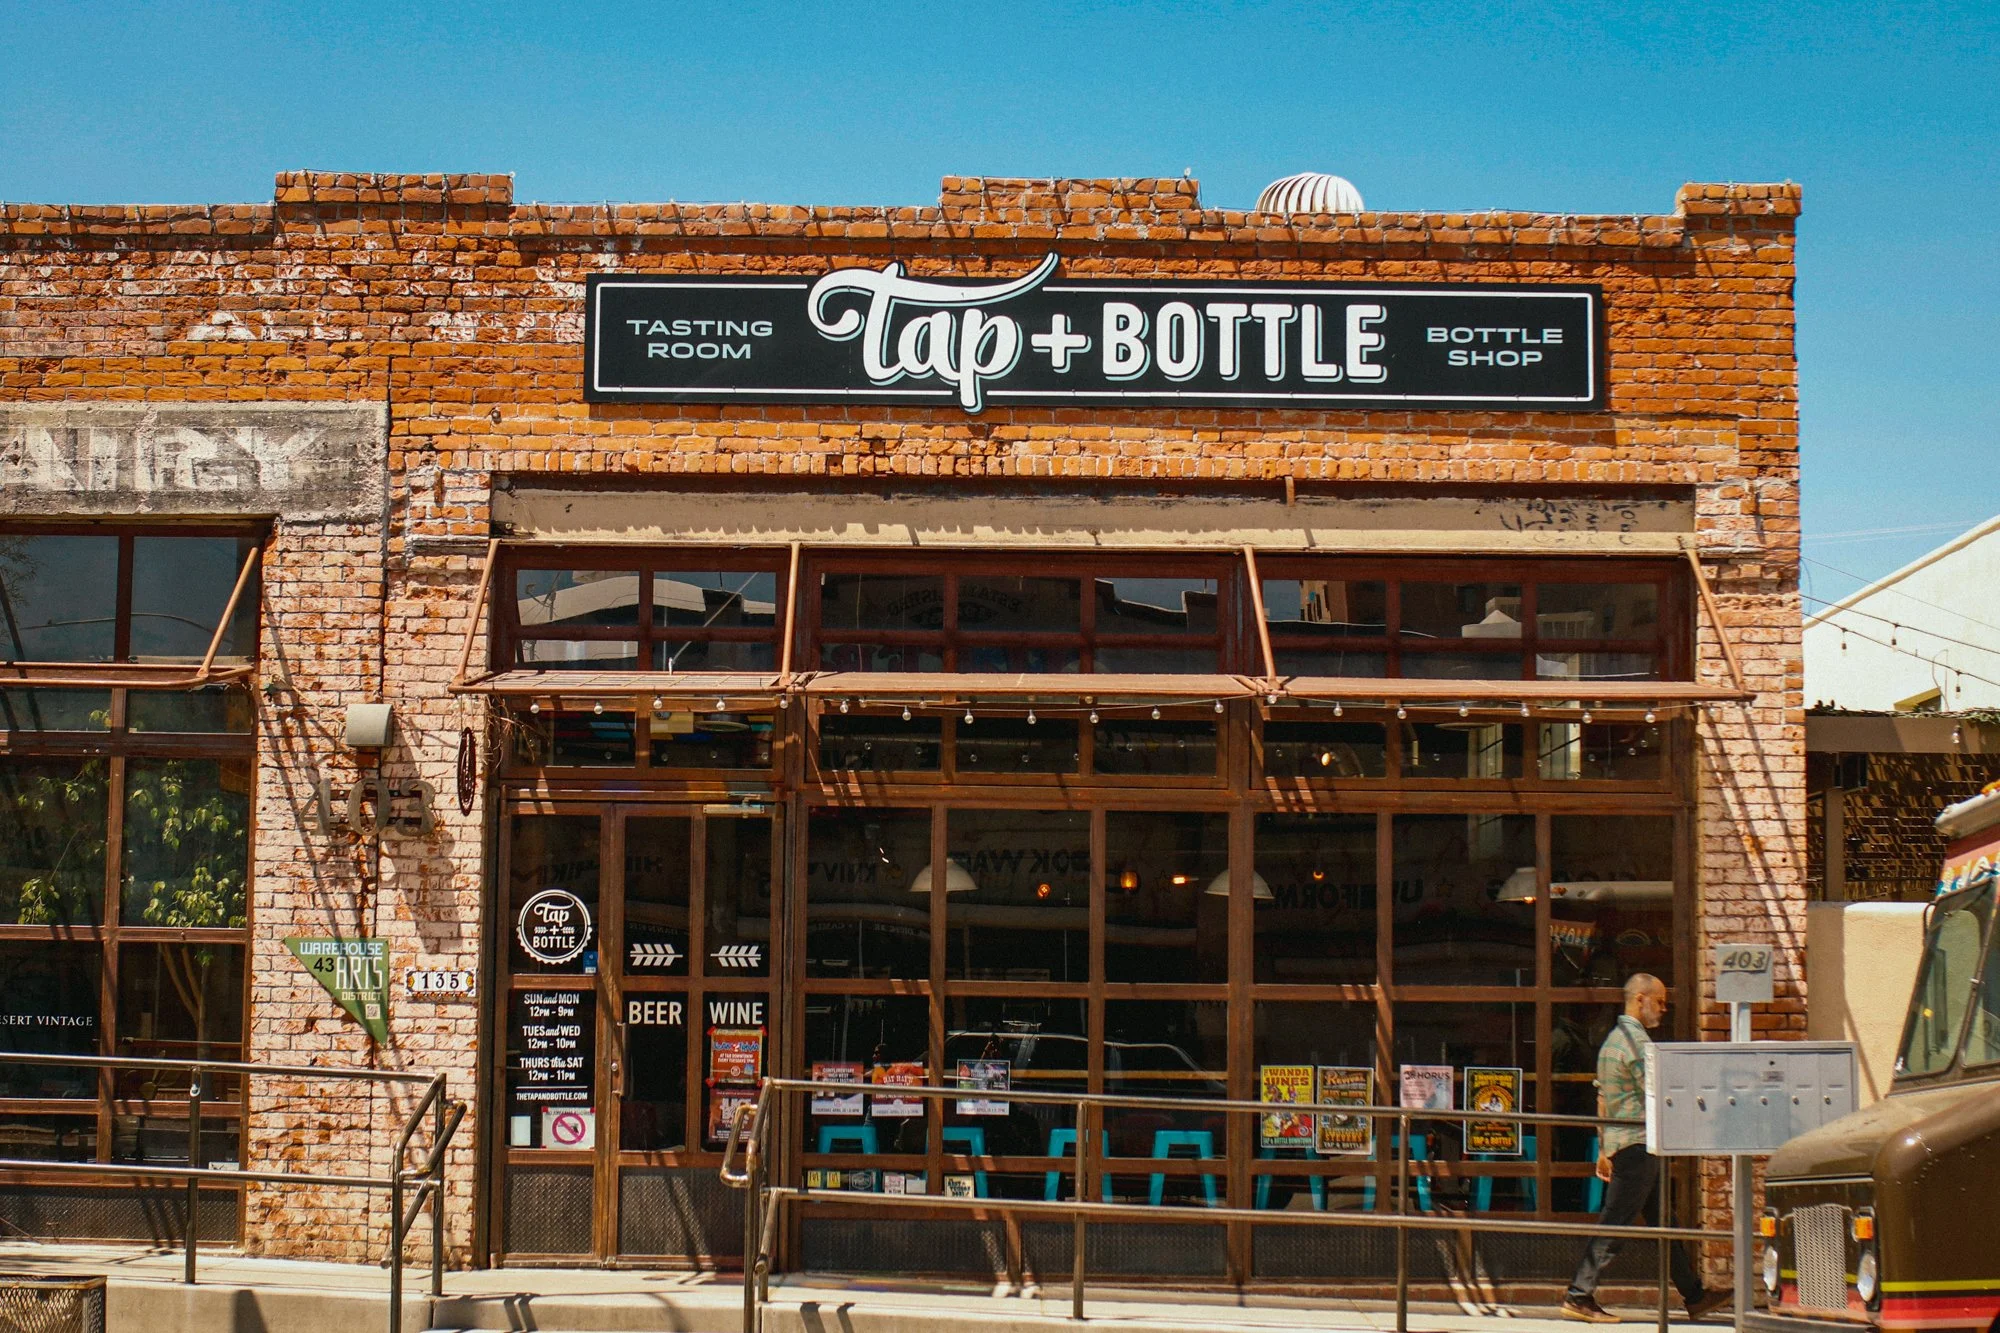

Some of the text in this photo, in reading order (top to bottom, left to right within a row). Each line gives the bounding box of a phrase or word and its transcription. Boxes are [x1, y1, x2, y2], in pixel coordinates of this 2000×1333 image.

[626, 319, 773, 337] TASTING
[808, 252, 1388, 414] Tap + BOTTLE
[1426, 326, 1564, 345] BOTTLE
[647, 342, 751, 360] ROOM
[1447, 349, 1544, 368] SHOP
[302, 778, 437, 838] 403
[534, 902, 575, 927] Tap
[533, 936, 575, 948] BOTTLE
[300, 943, 383, 956] WAREHOUSE
[313, 957, 335, 972] 43
[1723, 951, 1766, 969] 403
[335, 956, 383, 990] ARTS
[421, 973, 459, 989] 135
[341, 991, 381, 1000] DISTRICT
[524, 992, 580, 1004] SUN and MON
[530, 1006, 549, 1016] 12PM
[558, 1006, 573, 1016] 9PM
[628, 1001, 682, 1025] BEER
[709, 1002, 763, 1025] WINE
[37, 1016, 93, 1026] VINTAGE
[523, 1024, 580, 1036] TUES and WED
[528, 1038, 547, 1048] 12PM
[556, 1038, 576, 1048] 10PM
[520, 1056, 584, 1068] THURS thru SAT
[528, 1070, 548, 1080] 12PM
[557, 1070, 576, 1080] 11PM
[1269, 1068, 1309, 1076] WANDA
[1264, 1077, 1309, 1087] JUNES
[516, 1092, 588, 1101] THETAPANDBOTTLE.COM
